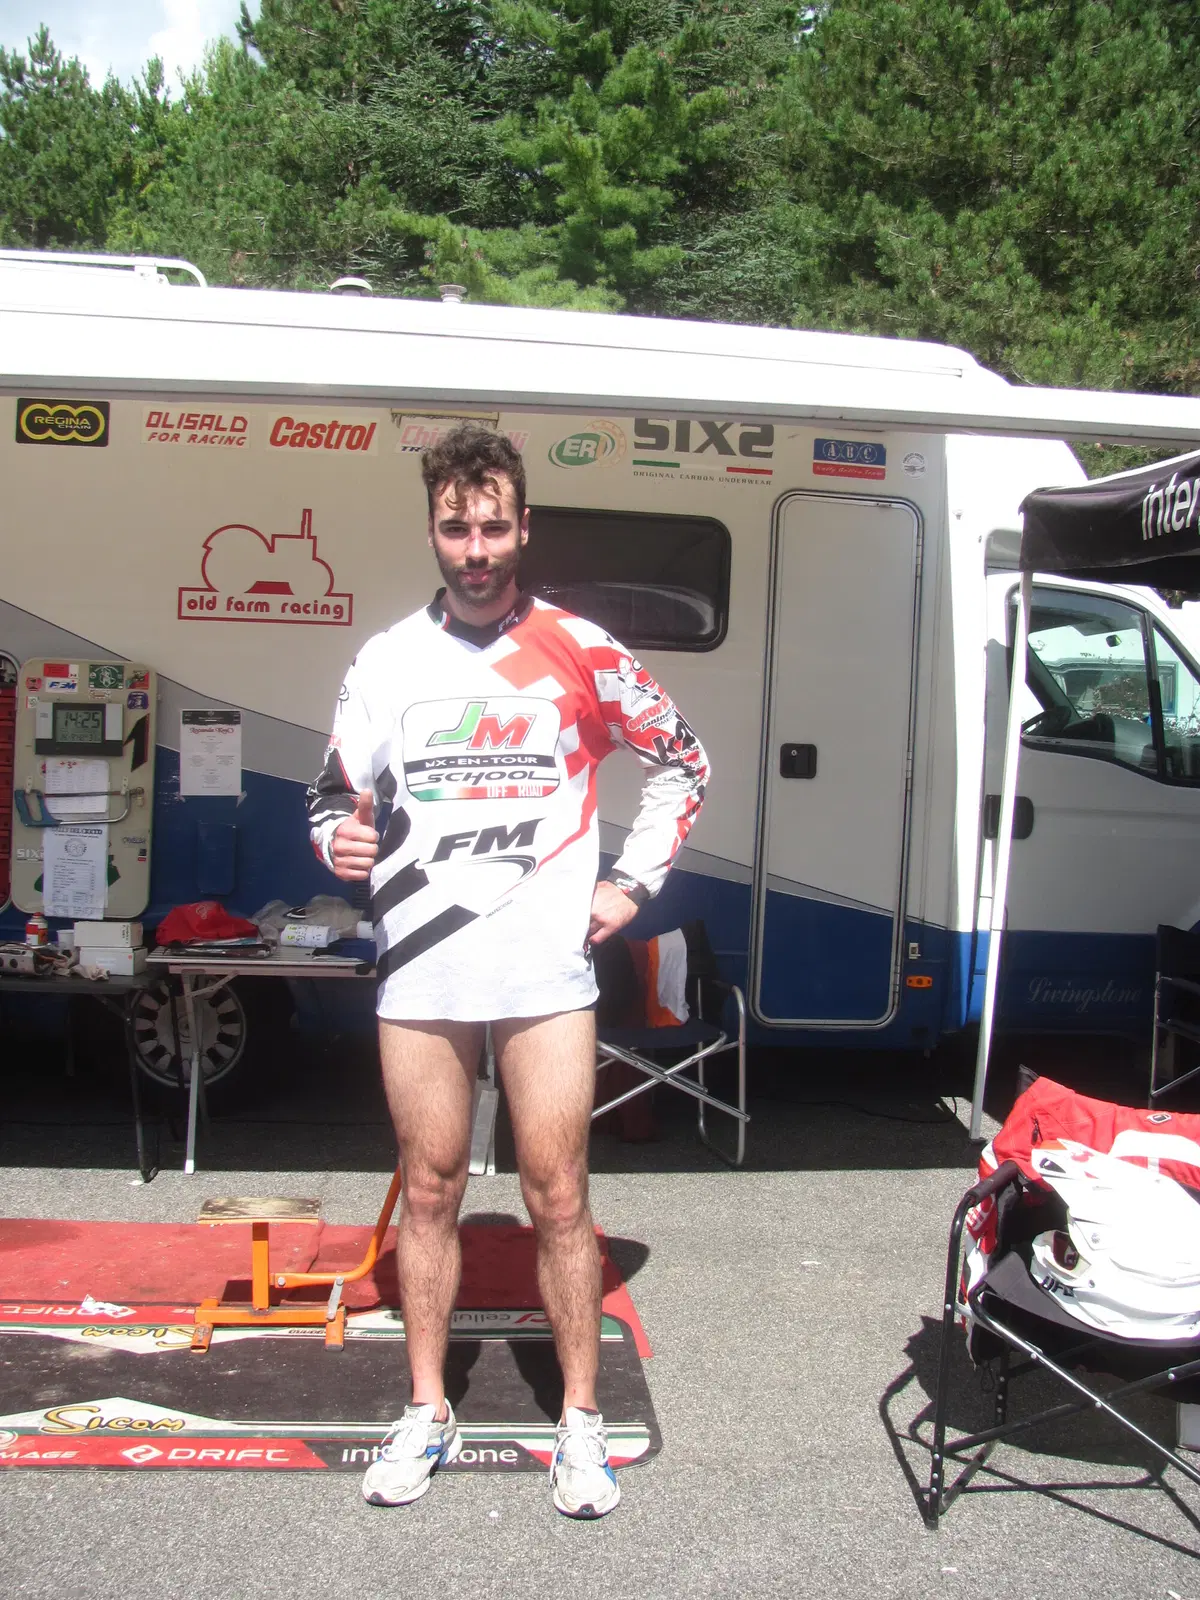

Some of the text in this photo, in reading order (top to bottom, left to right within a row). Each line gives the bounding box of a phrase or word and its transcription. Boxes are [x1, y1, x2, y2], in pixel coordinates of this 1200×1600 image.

[34, 416, 91, 426] REGINA
[148, 432, 247, 446] FOR RACING
[269, 416, 377, 451] Castrol
[633, 471, 772, 486] ORIGINAL CARBON UNDERWEAR
[1142, 472, 1200, 541] inter
[187, 596, 344, 619] old farm racing
[64, 711, 100, 728] 14:25
[425, 701, 538, 750] JM
[425, 757, 538, 768] MX-EN-TOUR
[427, 770, 537, 786] SCHOOL
[1027, 978, 1141, 1012] Livingstone
[167, 1447, 291, 1462] DRIFT
[342, 1446, 518, 1463] intone
